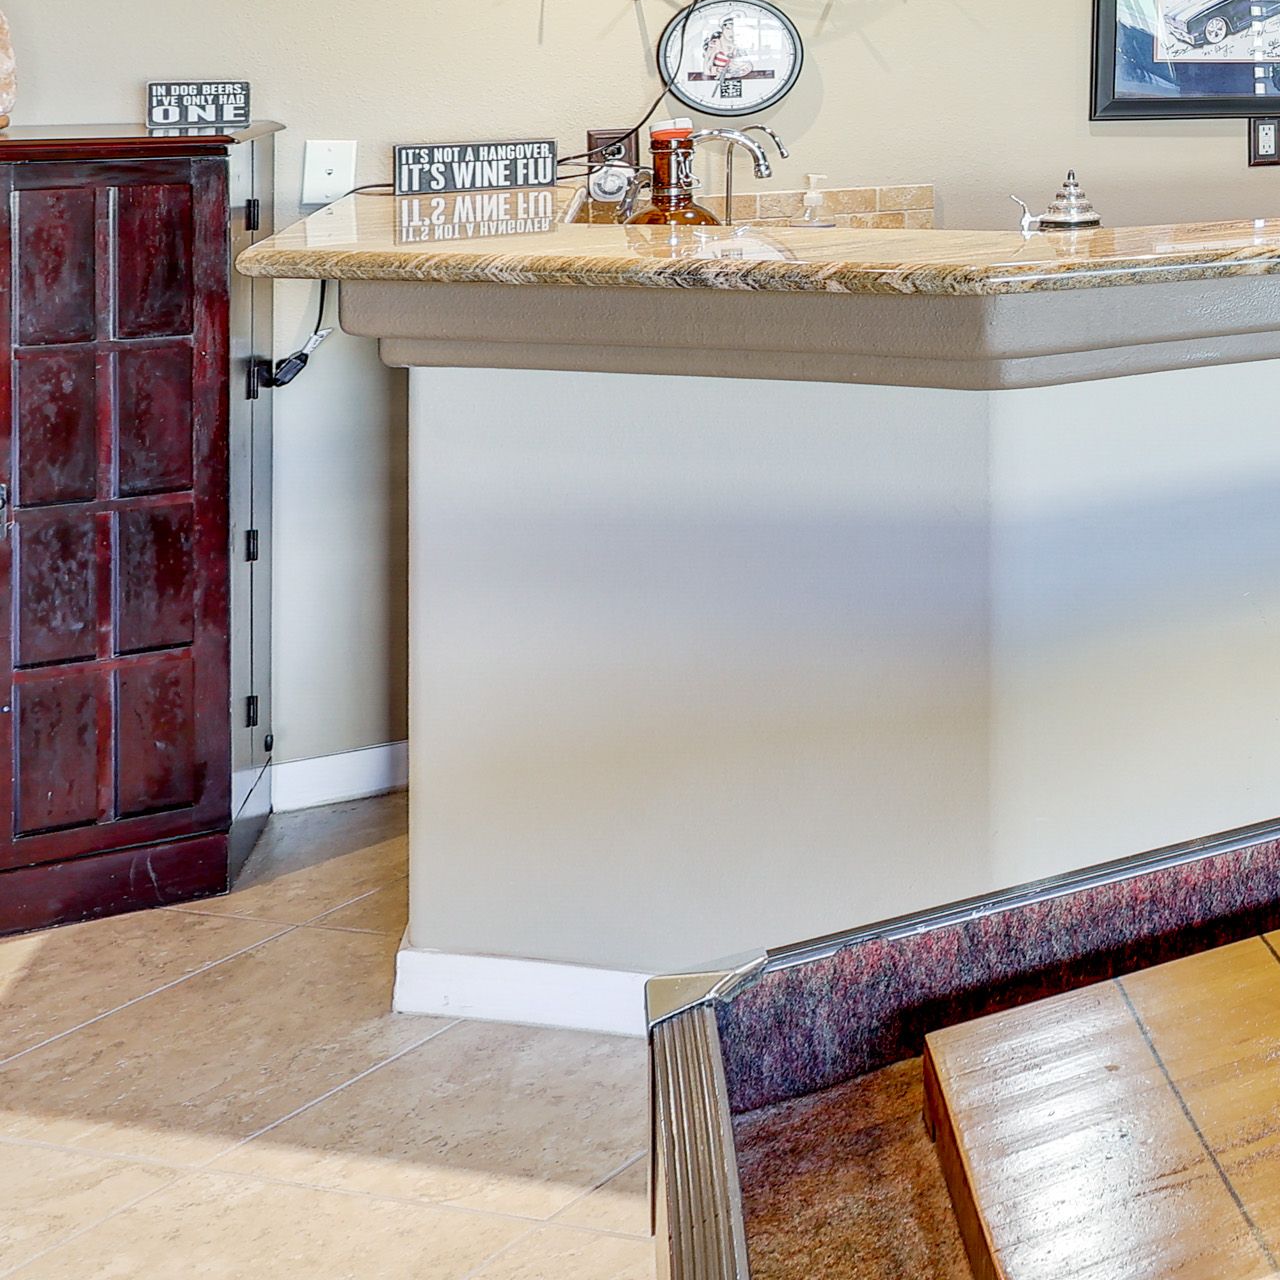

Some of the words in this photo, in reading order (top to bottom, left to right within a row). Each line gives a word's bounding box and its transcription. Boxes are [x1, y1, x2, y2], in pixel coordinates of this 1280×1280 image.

[152, 85, 166, 95] IN
[171, 85, 198, 95] DOG
[152, 96, 179, 107] I'VE
[183, 95, 214, 106] ONLY
[218, 94, 245, 104] HAD
[152, 104, 246, 123] ONE
[401, 149, 429, 164] IT'S
[433, 147, 460, 162] NOT
[465, 146, 475, 161] A
[401, 163, 446, 192] IT'S
[452, 160, 511, 189] WINE
[516, 157, 553, 185] FLU
